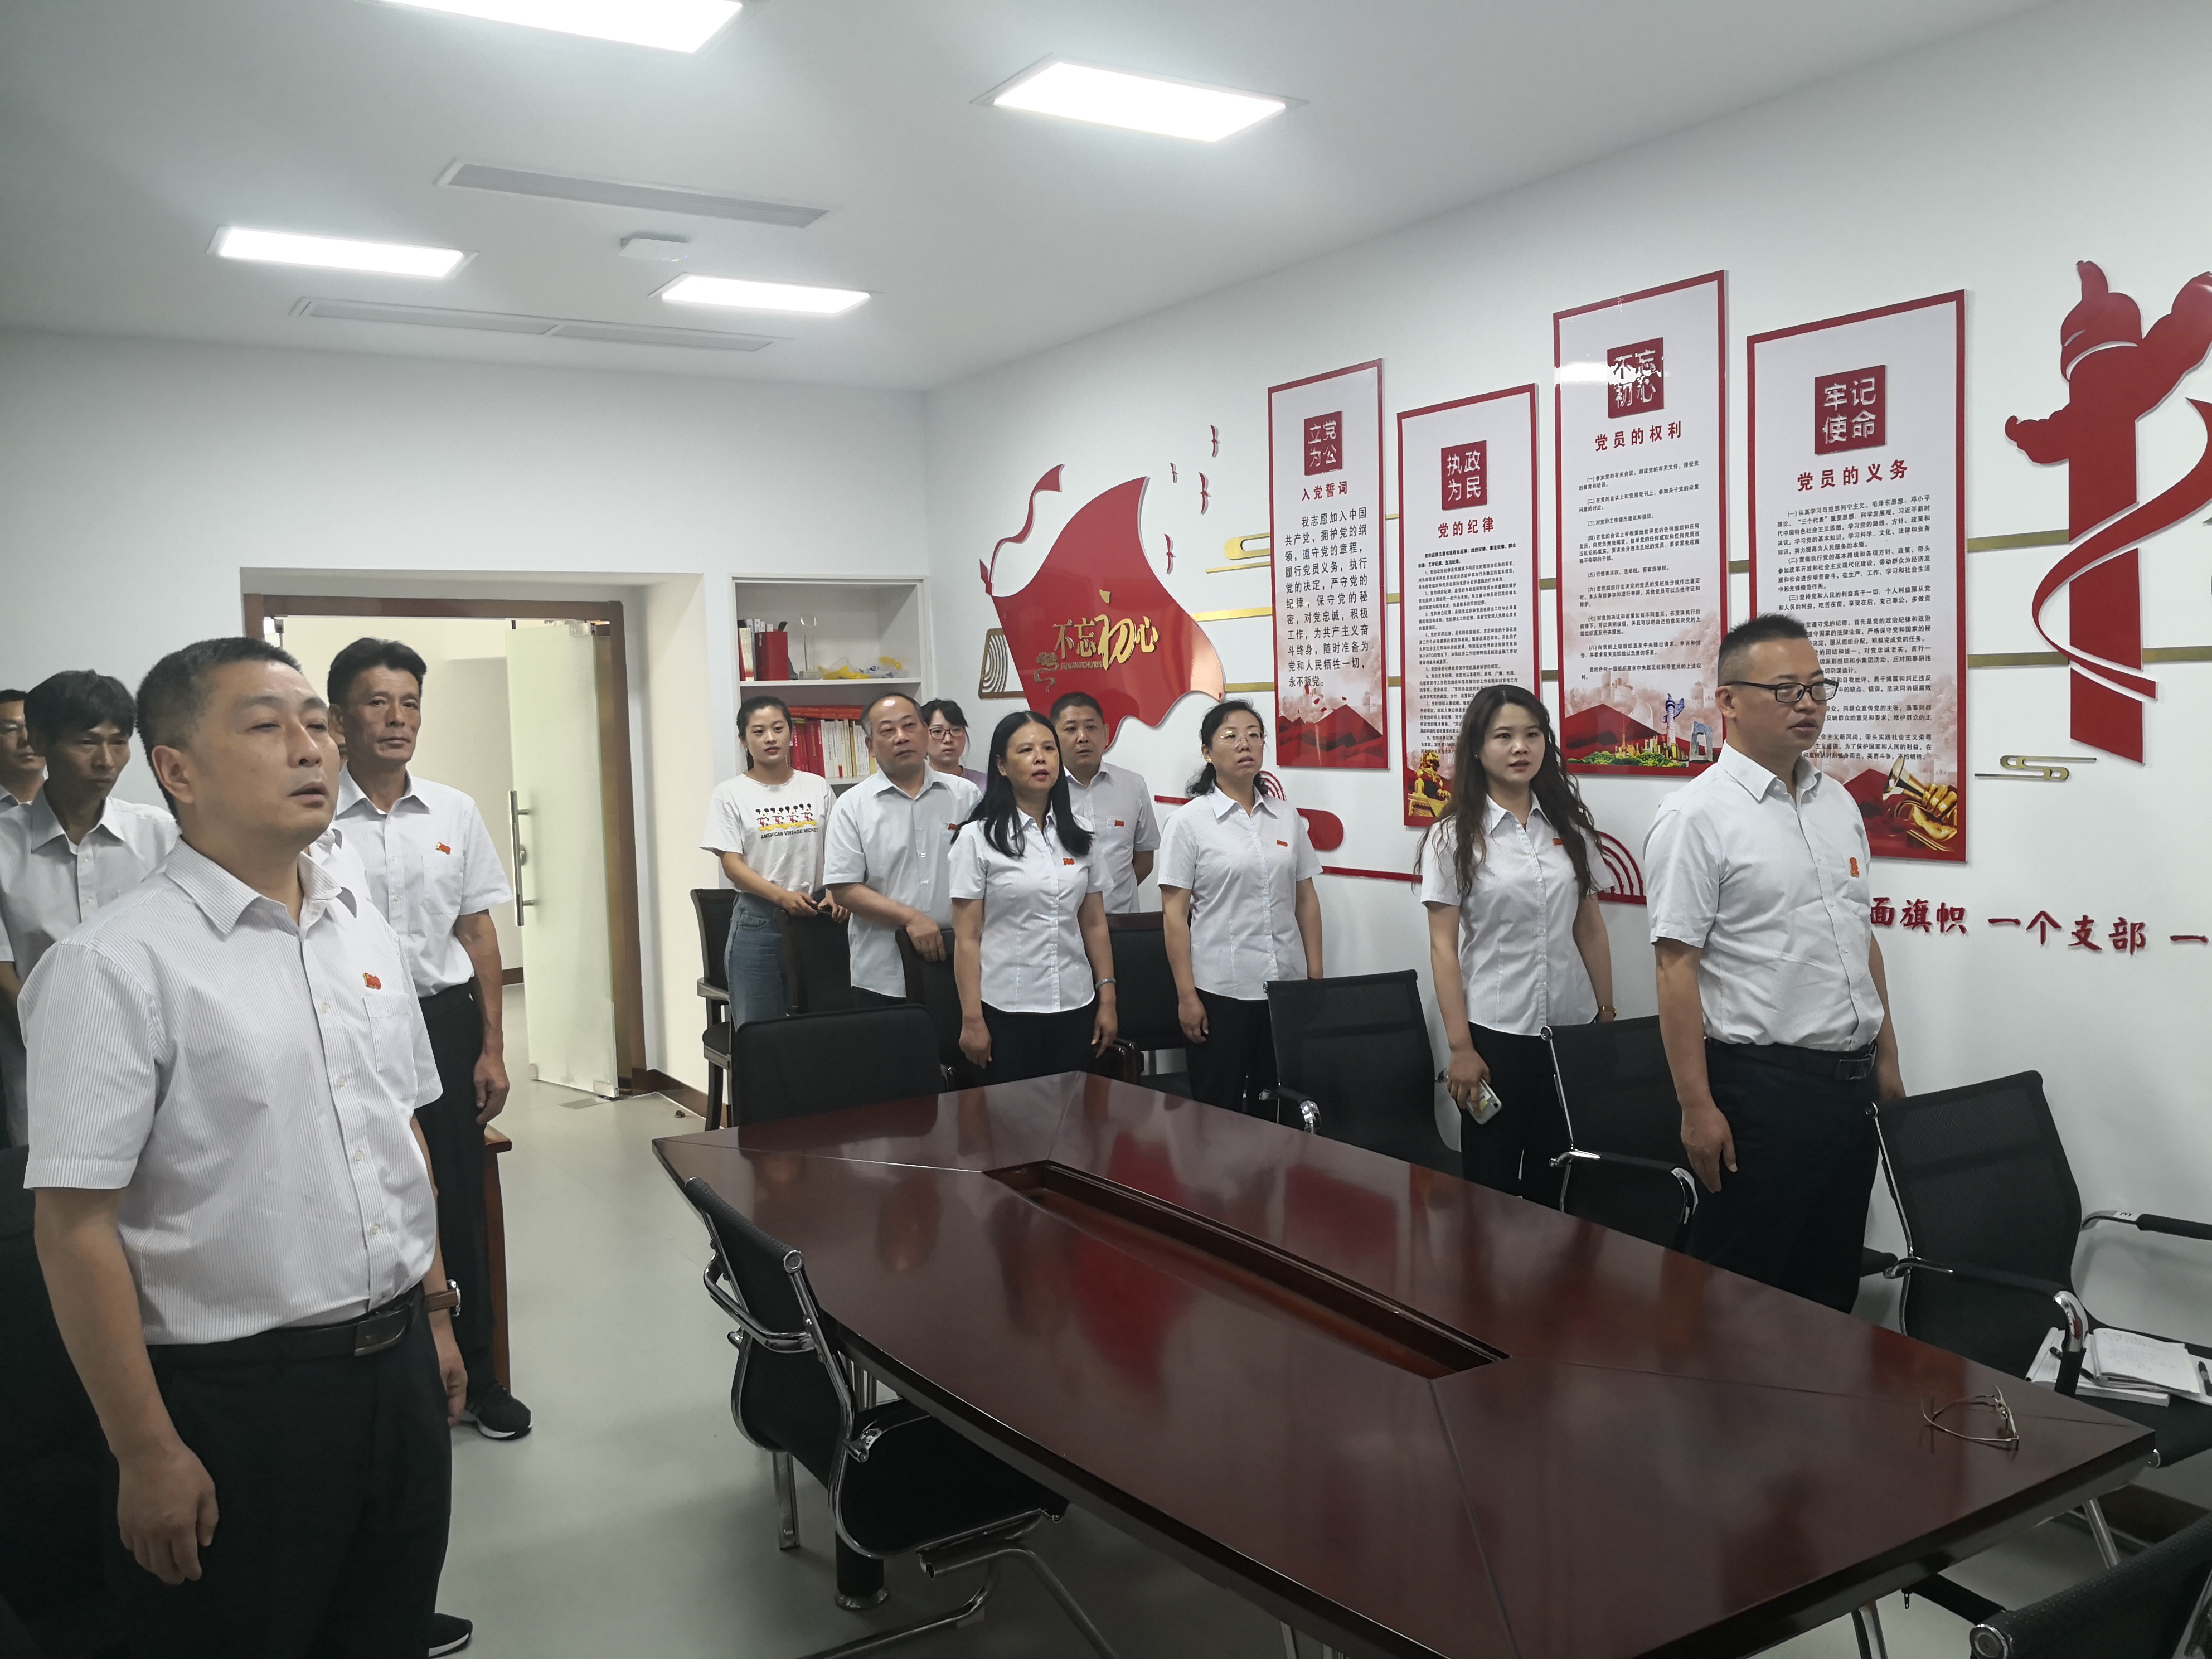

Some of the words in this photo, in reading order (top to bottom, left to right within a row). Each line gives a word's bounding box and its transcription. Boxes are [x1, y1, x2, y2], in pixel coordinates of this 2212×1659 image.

[1613, 349, 1656, 379] 不忘
[1614, 379, 1656, 409] 初心
[1823, 376, 1876, 411] 牢记
[1308, 419, 1336, 444] 立党
[1595, 421, 1681, 452] 党员的权利
[1823, 410, 1876, 444] 使命
[1309, 444, 1337, 467] 为公
[1447, 449, 1481, 477] 执政
[1797, 459, 1908, 492] 党员的义务
[1302, 481, 1347, 501] 入党誓词
[1448, 475, 1481, 501] 为民
[1302, 507, 1366, 528] 我志愿加入中国
[1438, 516, 1494, 539] 党的纪律
[1285, 524, 1367, 546] 共产党，拥护党的纲
[1285, 542, 1362, 561] 领，遵守党的章程，
[1286, 557, 1367, 578] 履行党员义务，执行
[1286, 574, 1367, 594] 党的决定，严守党的
[1778, 583, 1827, 592] 中起先锋模范作用。
[1286, 590, 1367, 609] 纪律，保守党的秘
[1287, 607, 1368, 624] 密，对党忠诚，积极
[1053, 589, 1159, 670] 不忘初心
[1287, 623, 1368, 639] 工作，为共产主义奋
[1288, 640, 1368, 656] 斗终身，随时准备为
[1288, 657, 1365, 672] 党和人民牺牲一切，
[1288, 675, 1323, 687] 永不叛党。
[1870, 897, 1966, 934] 面旗帜
[1988, 911, 2146, 955] 一个支部
